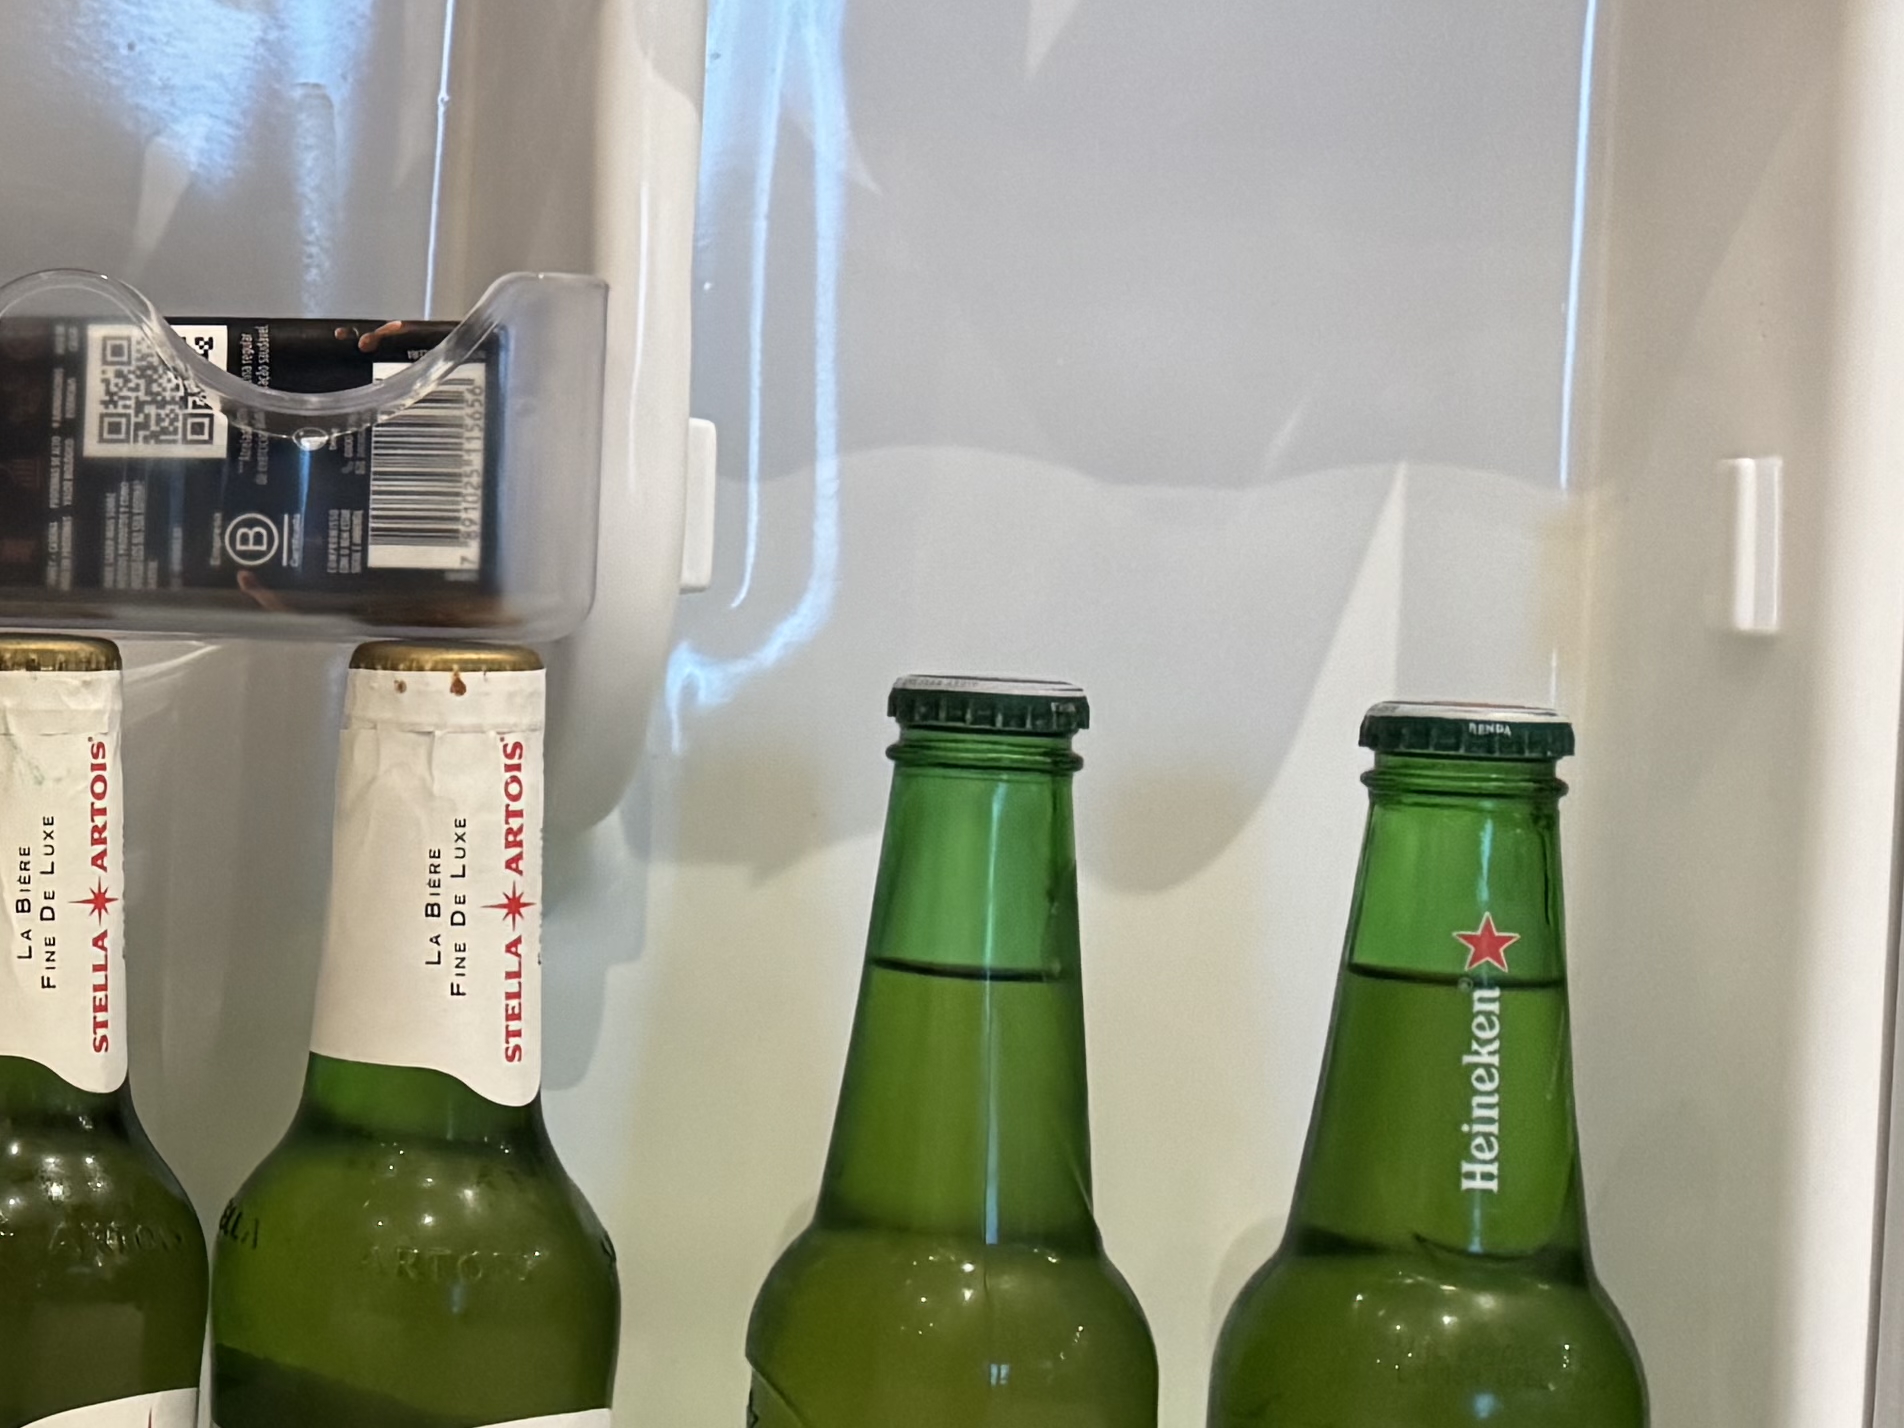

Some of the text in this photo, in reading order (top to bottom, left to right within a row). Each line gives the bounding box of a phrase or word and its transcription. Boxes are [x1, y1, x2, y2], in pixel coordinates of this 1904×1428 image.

[90, 740, 110, 1054] STELLA ARTOIS
[503, 740, 524, 1064] STELLA ARTOIS
[1461, 987, 1501, 1194] Heineken
